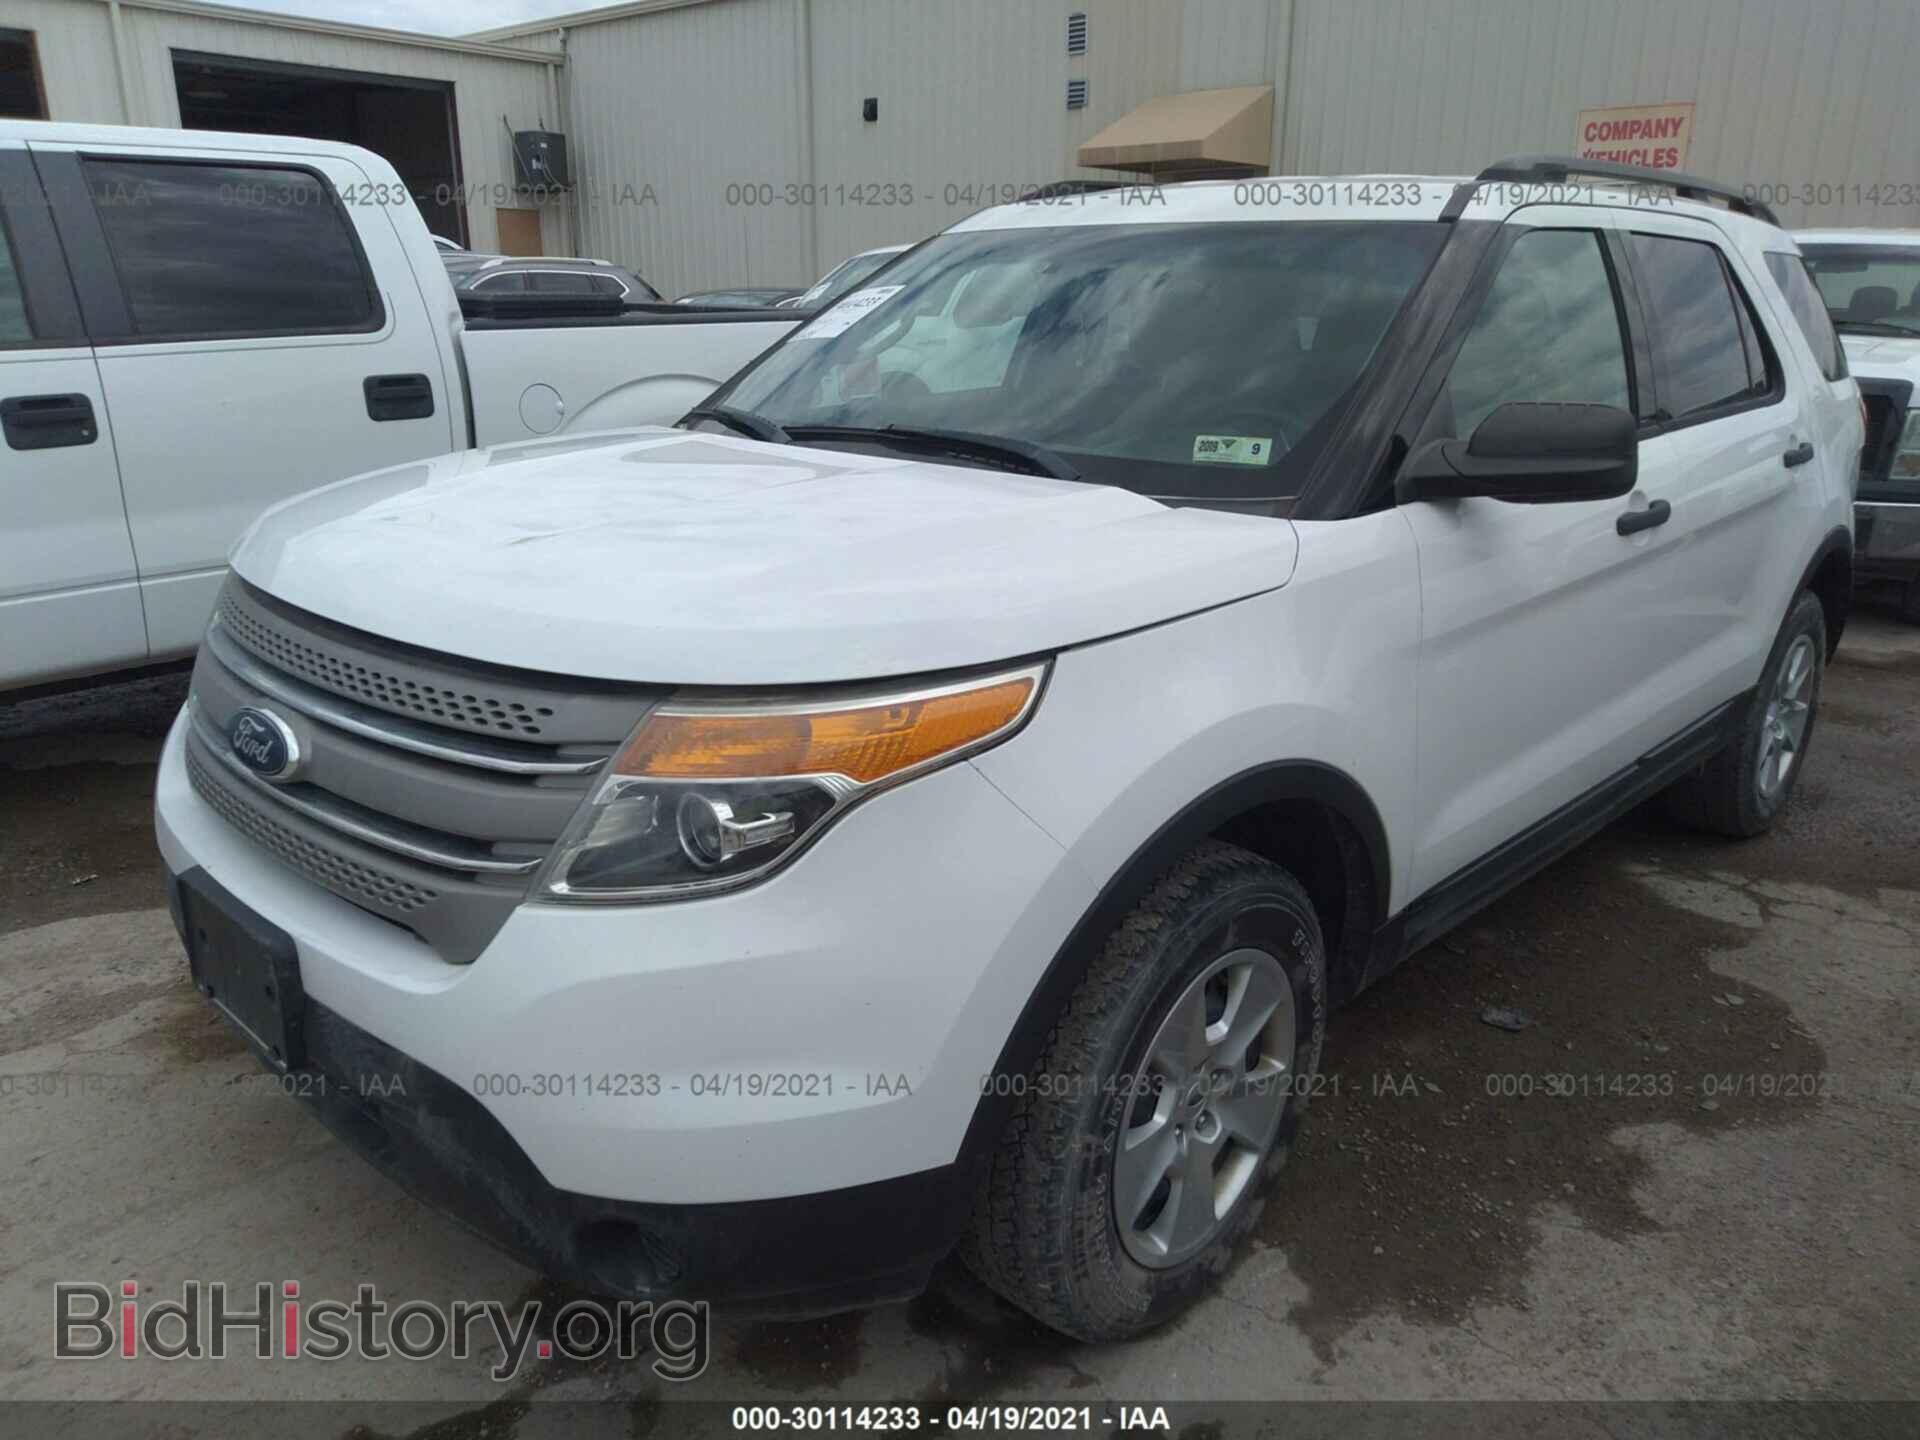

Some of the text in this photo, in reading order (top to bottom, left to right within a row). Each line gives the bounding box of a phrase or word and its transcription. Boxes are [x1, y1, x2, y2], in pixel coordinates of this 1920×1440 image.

[1584, 116, 1685, 142] COMPANY
[1251, 443, 1262, 456] 9
[233, 716, 274, 764] Ford
